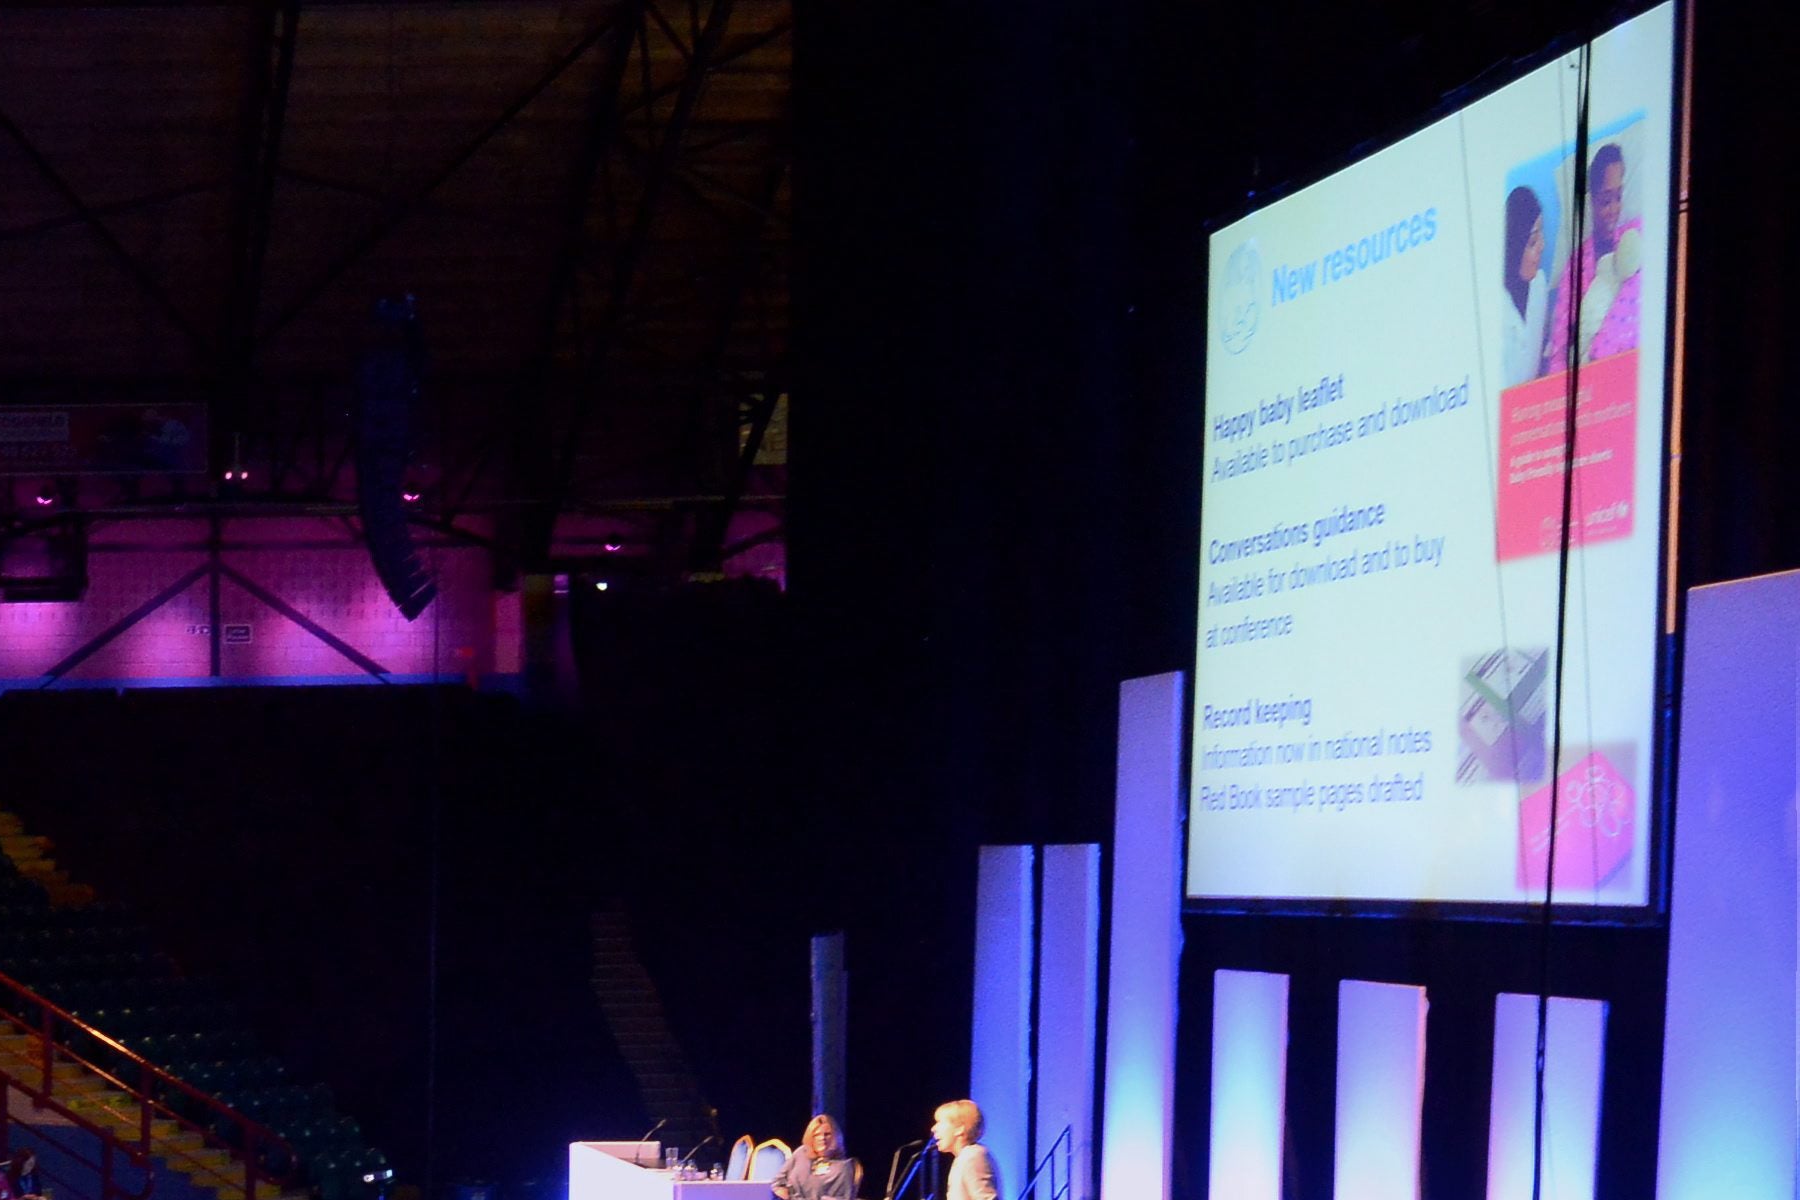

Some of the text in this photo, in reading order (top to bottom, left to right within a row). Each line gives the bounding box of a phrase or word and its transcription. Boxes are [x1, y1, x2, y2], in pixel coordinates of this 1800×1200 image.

[1271, 207, 1438, 307] New resources
[1211, 442, 1268, 482] Available
[1272, 441, 1285, 465] to
[1288, 422, 1352, 467] purchase
[1357, 402, 1386, 438] and
[1391, 374, 1469, 429] download
[1213, 373, 1344, 442] Happy baby leaflet
[1208, 503, 1385, 566] Conversations guidance
[1207, 534, 1446, 607] Available for download and to buy
[1206, 613, 1293, 649] at conference
[1203, 693, 1313, 730] Record keeping
[1201, 725, 1432, 771] Information now in national notes
[1201, 772, 1424, 813] Red Book sample pages drafted
